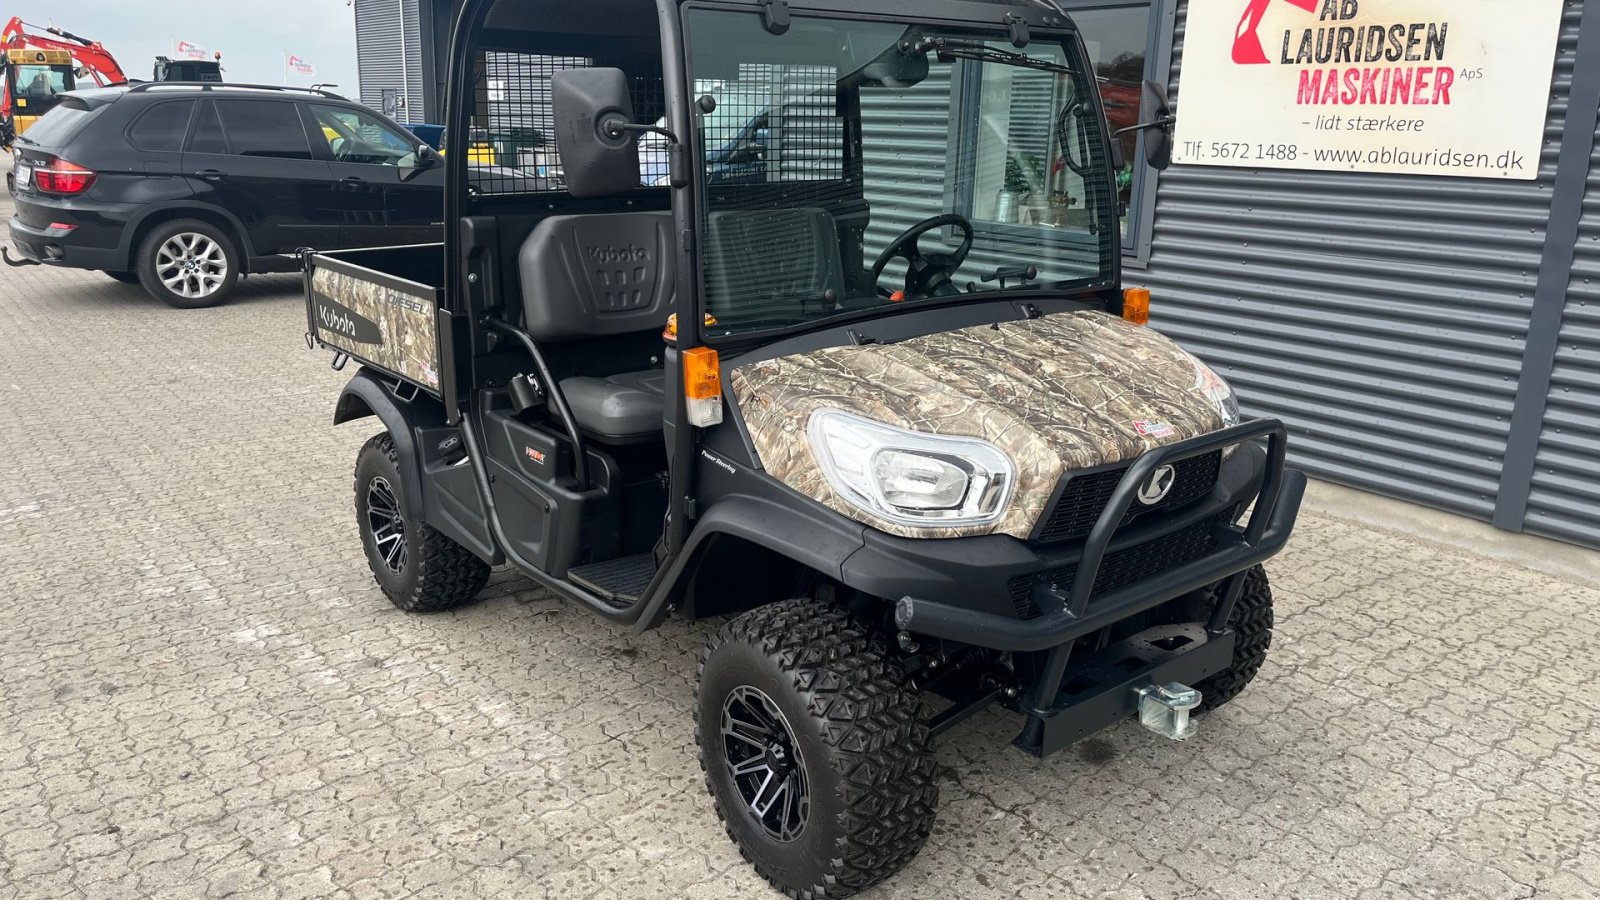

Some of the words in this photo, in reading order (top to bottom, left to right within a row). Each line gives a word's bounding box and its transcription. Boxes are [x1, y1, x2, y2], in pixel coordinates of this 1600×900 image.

[1280, 22, 1449, 64] LAURIDSEN
[1296, 66, 1455, 105] MASKINER
[1459, 67, 1484, 81] ApS
[1314, 114, 1342, 131] lidt
[1346, 115, 1425, 132] stærkere
[1183, 141, 1205, 161] Tlf.
[1210, 142, 1250, 159] 5672
[1255, 144, 1298, 161] 1488
[1313, 146, 1525, 170] www.ablauridsen.dk
[387, 293, 428, 316] DIESEL
[319, 303, 357, 337] Kubota
[701, 449, 717, 461] Power
[715, 458, 736, 474] Steering
